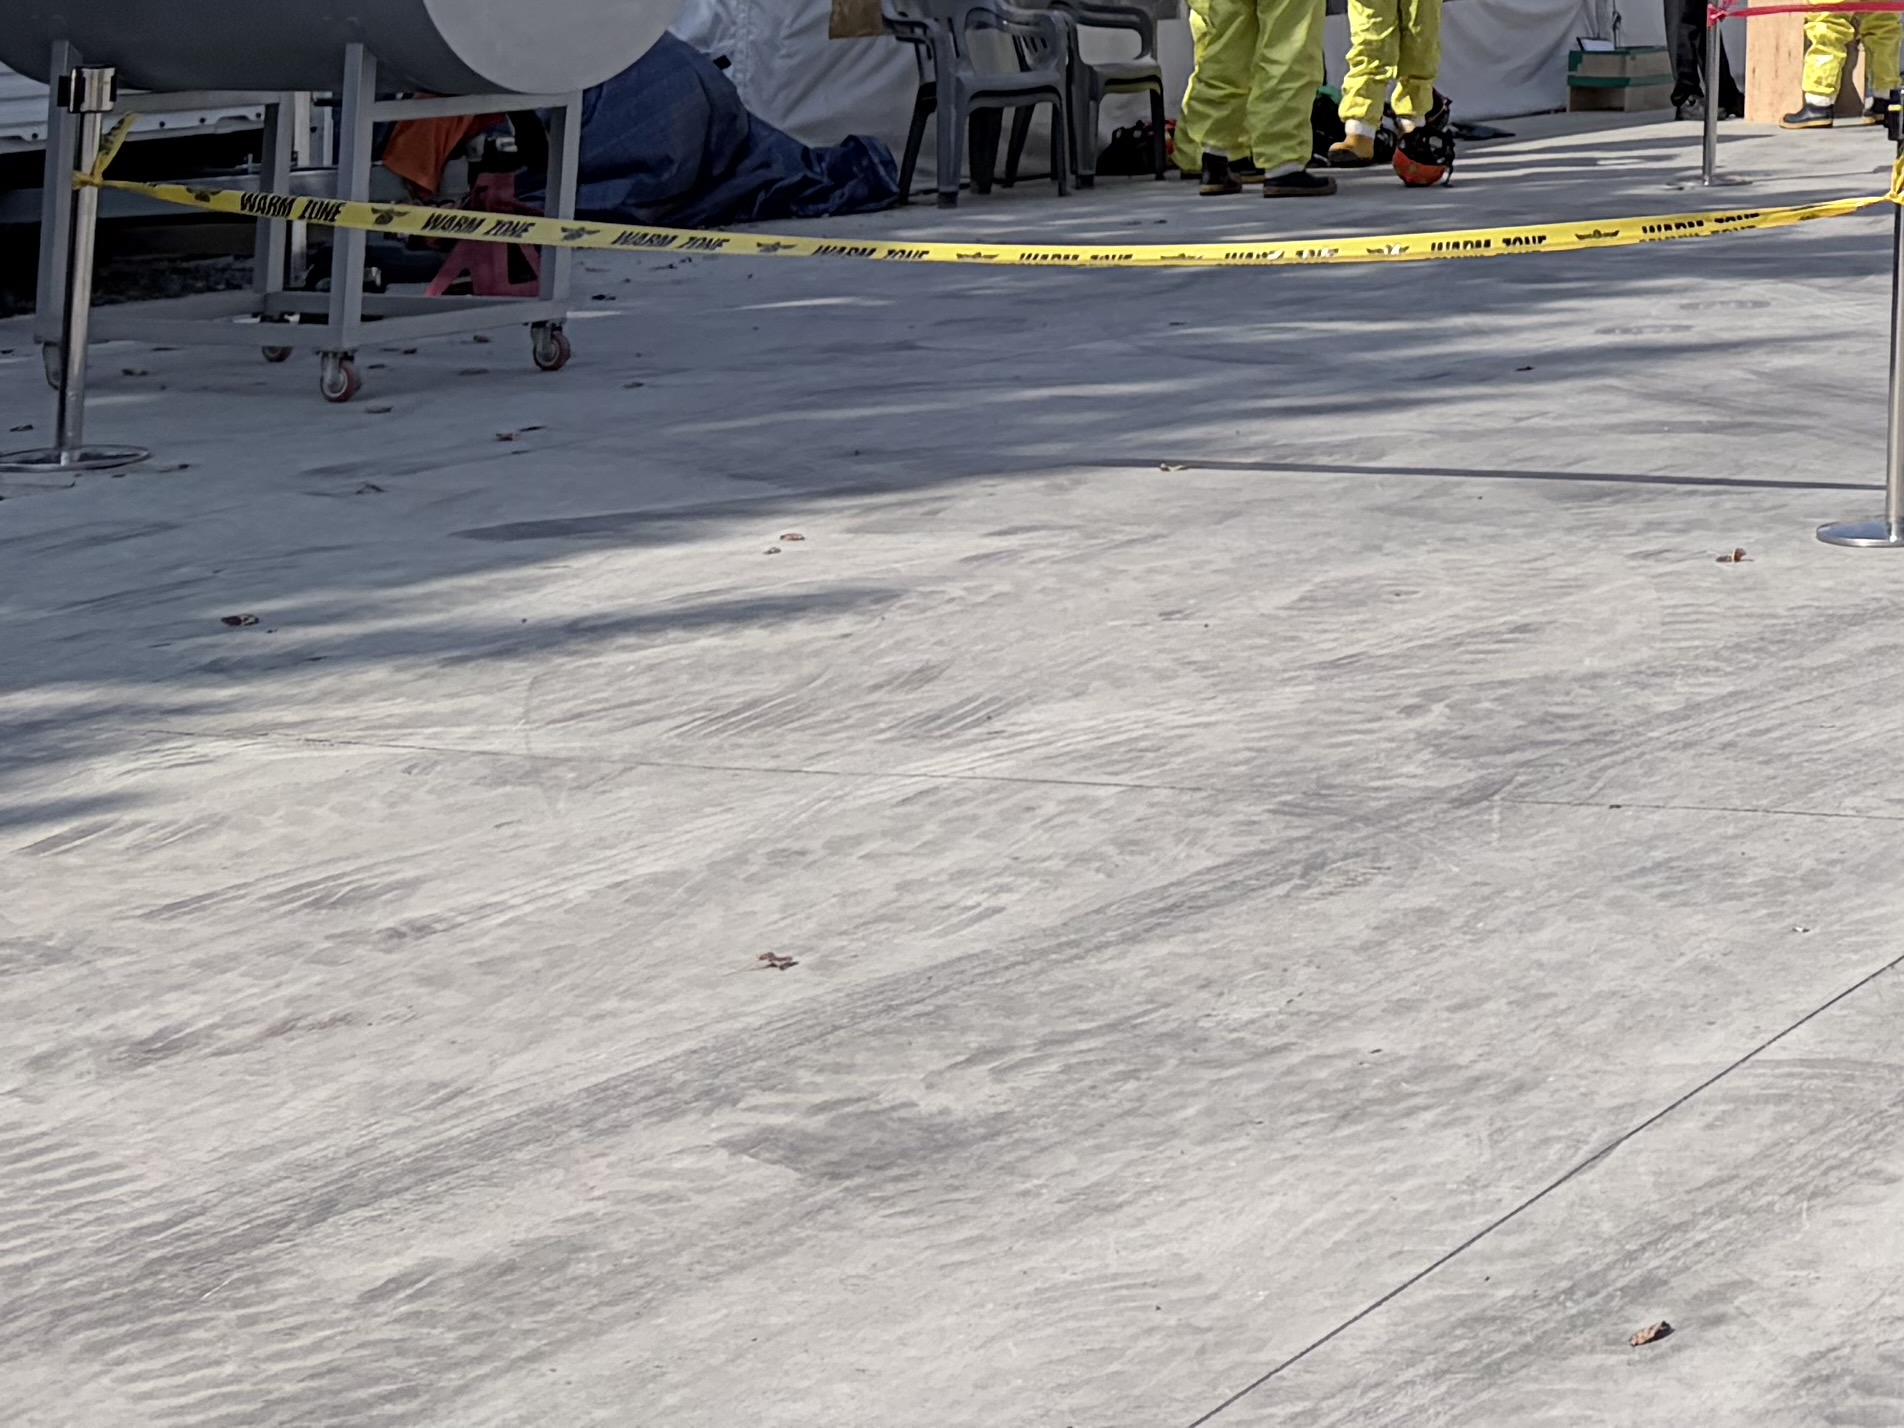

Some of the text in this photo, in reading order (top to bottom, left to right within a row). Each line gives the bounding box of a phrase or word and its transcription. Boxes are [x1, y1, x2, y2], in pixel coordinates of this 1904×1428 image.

[240, 192, 346, 222] WARM ZONE
[421, 212, 536, 239] WARM ZONE
